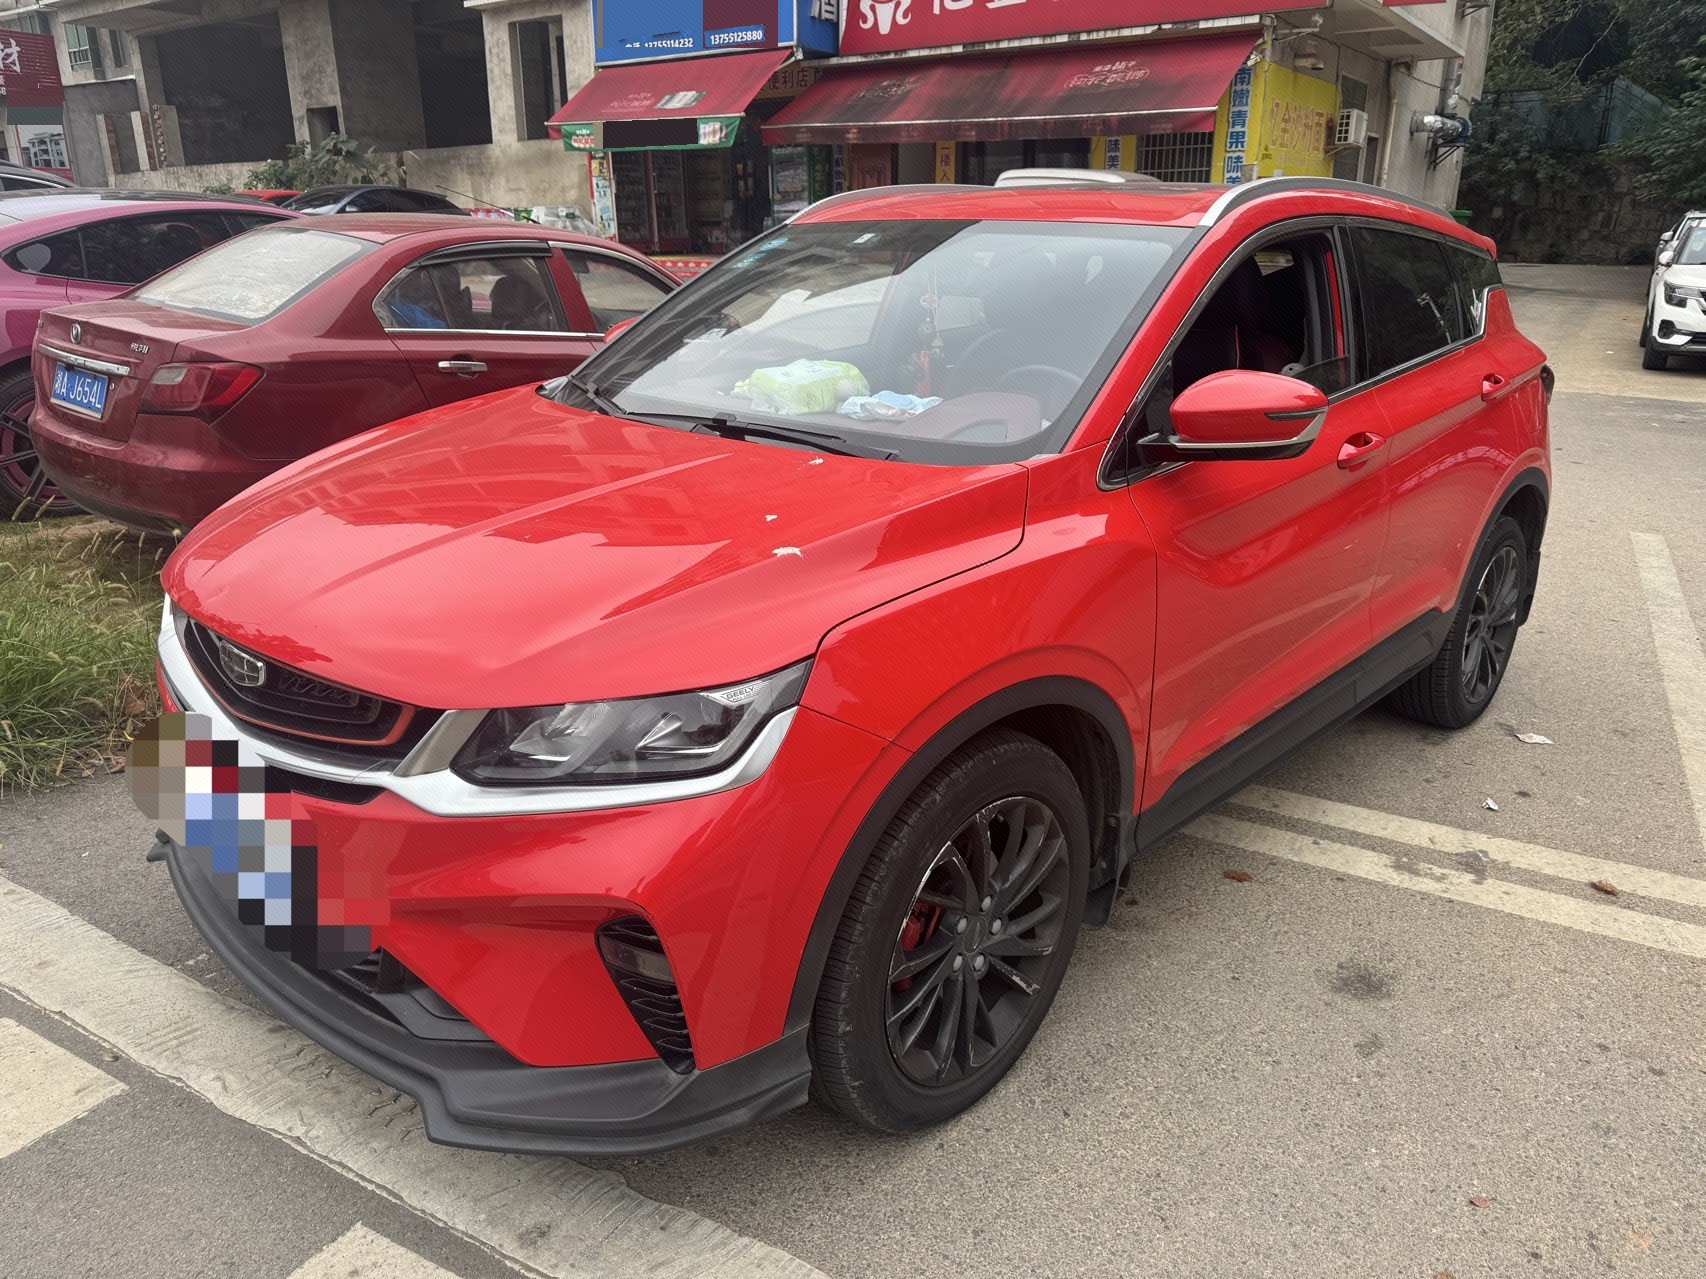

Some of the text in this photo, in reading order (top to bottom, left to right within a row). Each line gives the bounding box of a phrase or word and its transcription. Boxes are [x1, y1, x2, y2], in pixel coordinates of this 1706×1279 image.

[710, 30, 763, 45] 13755125880
[1268, 97, 1335, 157] 亿金炒粉面
[726, 686, 755, 699] GEELY
